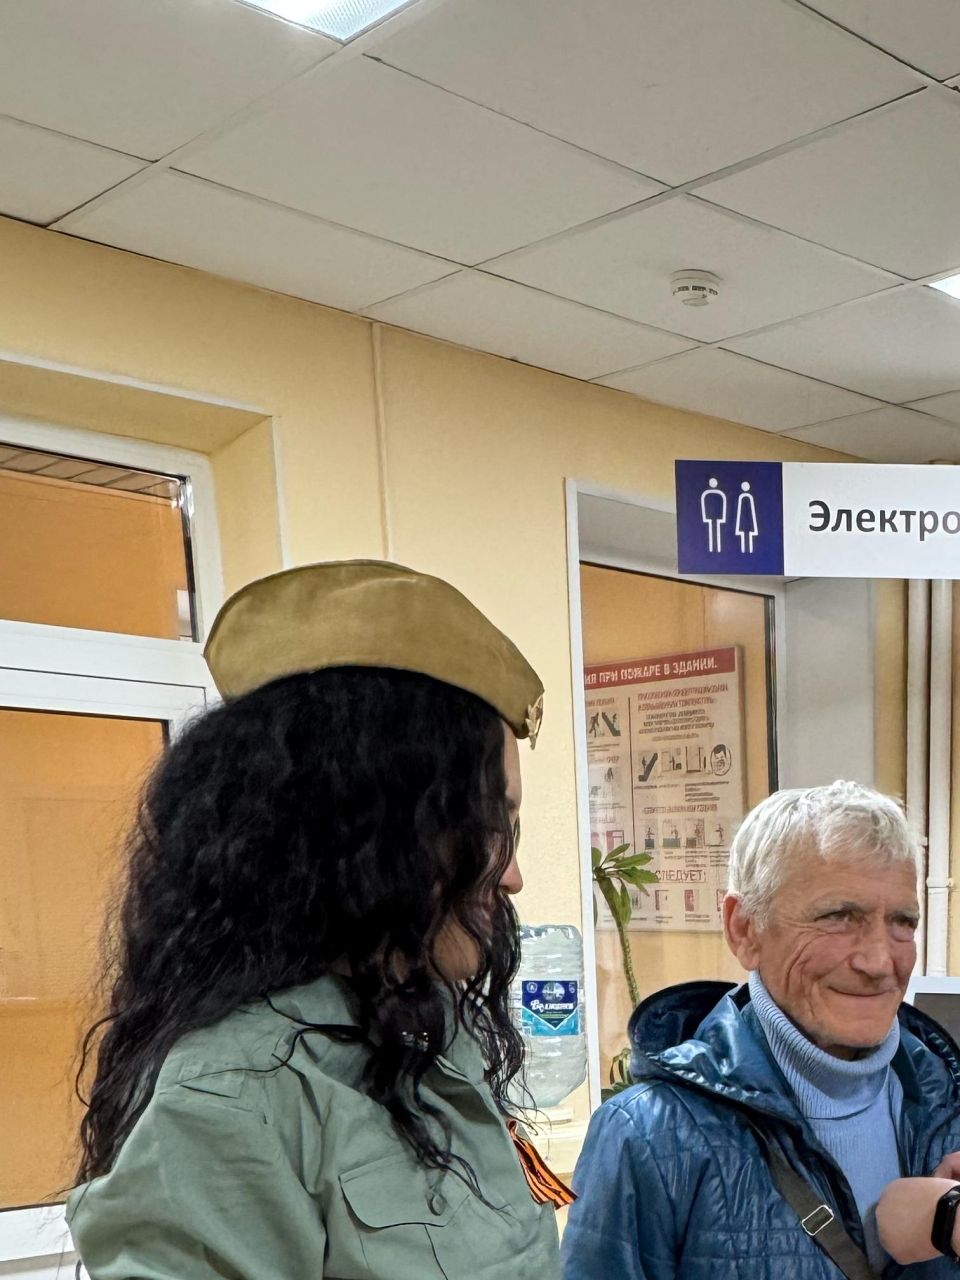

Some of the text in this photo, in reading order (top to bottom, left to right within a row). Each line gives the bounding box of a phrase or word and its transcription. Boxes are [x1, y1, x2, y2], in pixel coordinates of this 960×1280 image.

[599, 670, 618, 683] ПРИ
[621, 664, 661, 681] ПОЖАРЕ
[672, 656, 719, 675] ЗДАНИИ.
